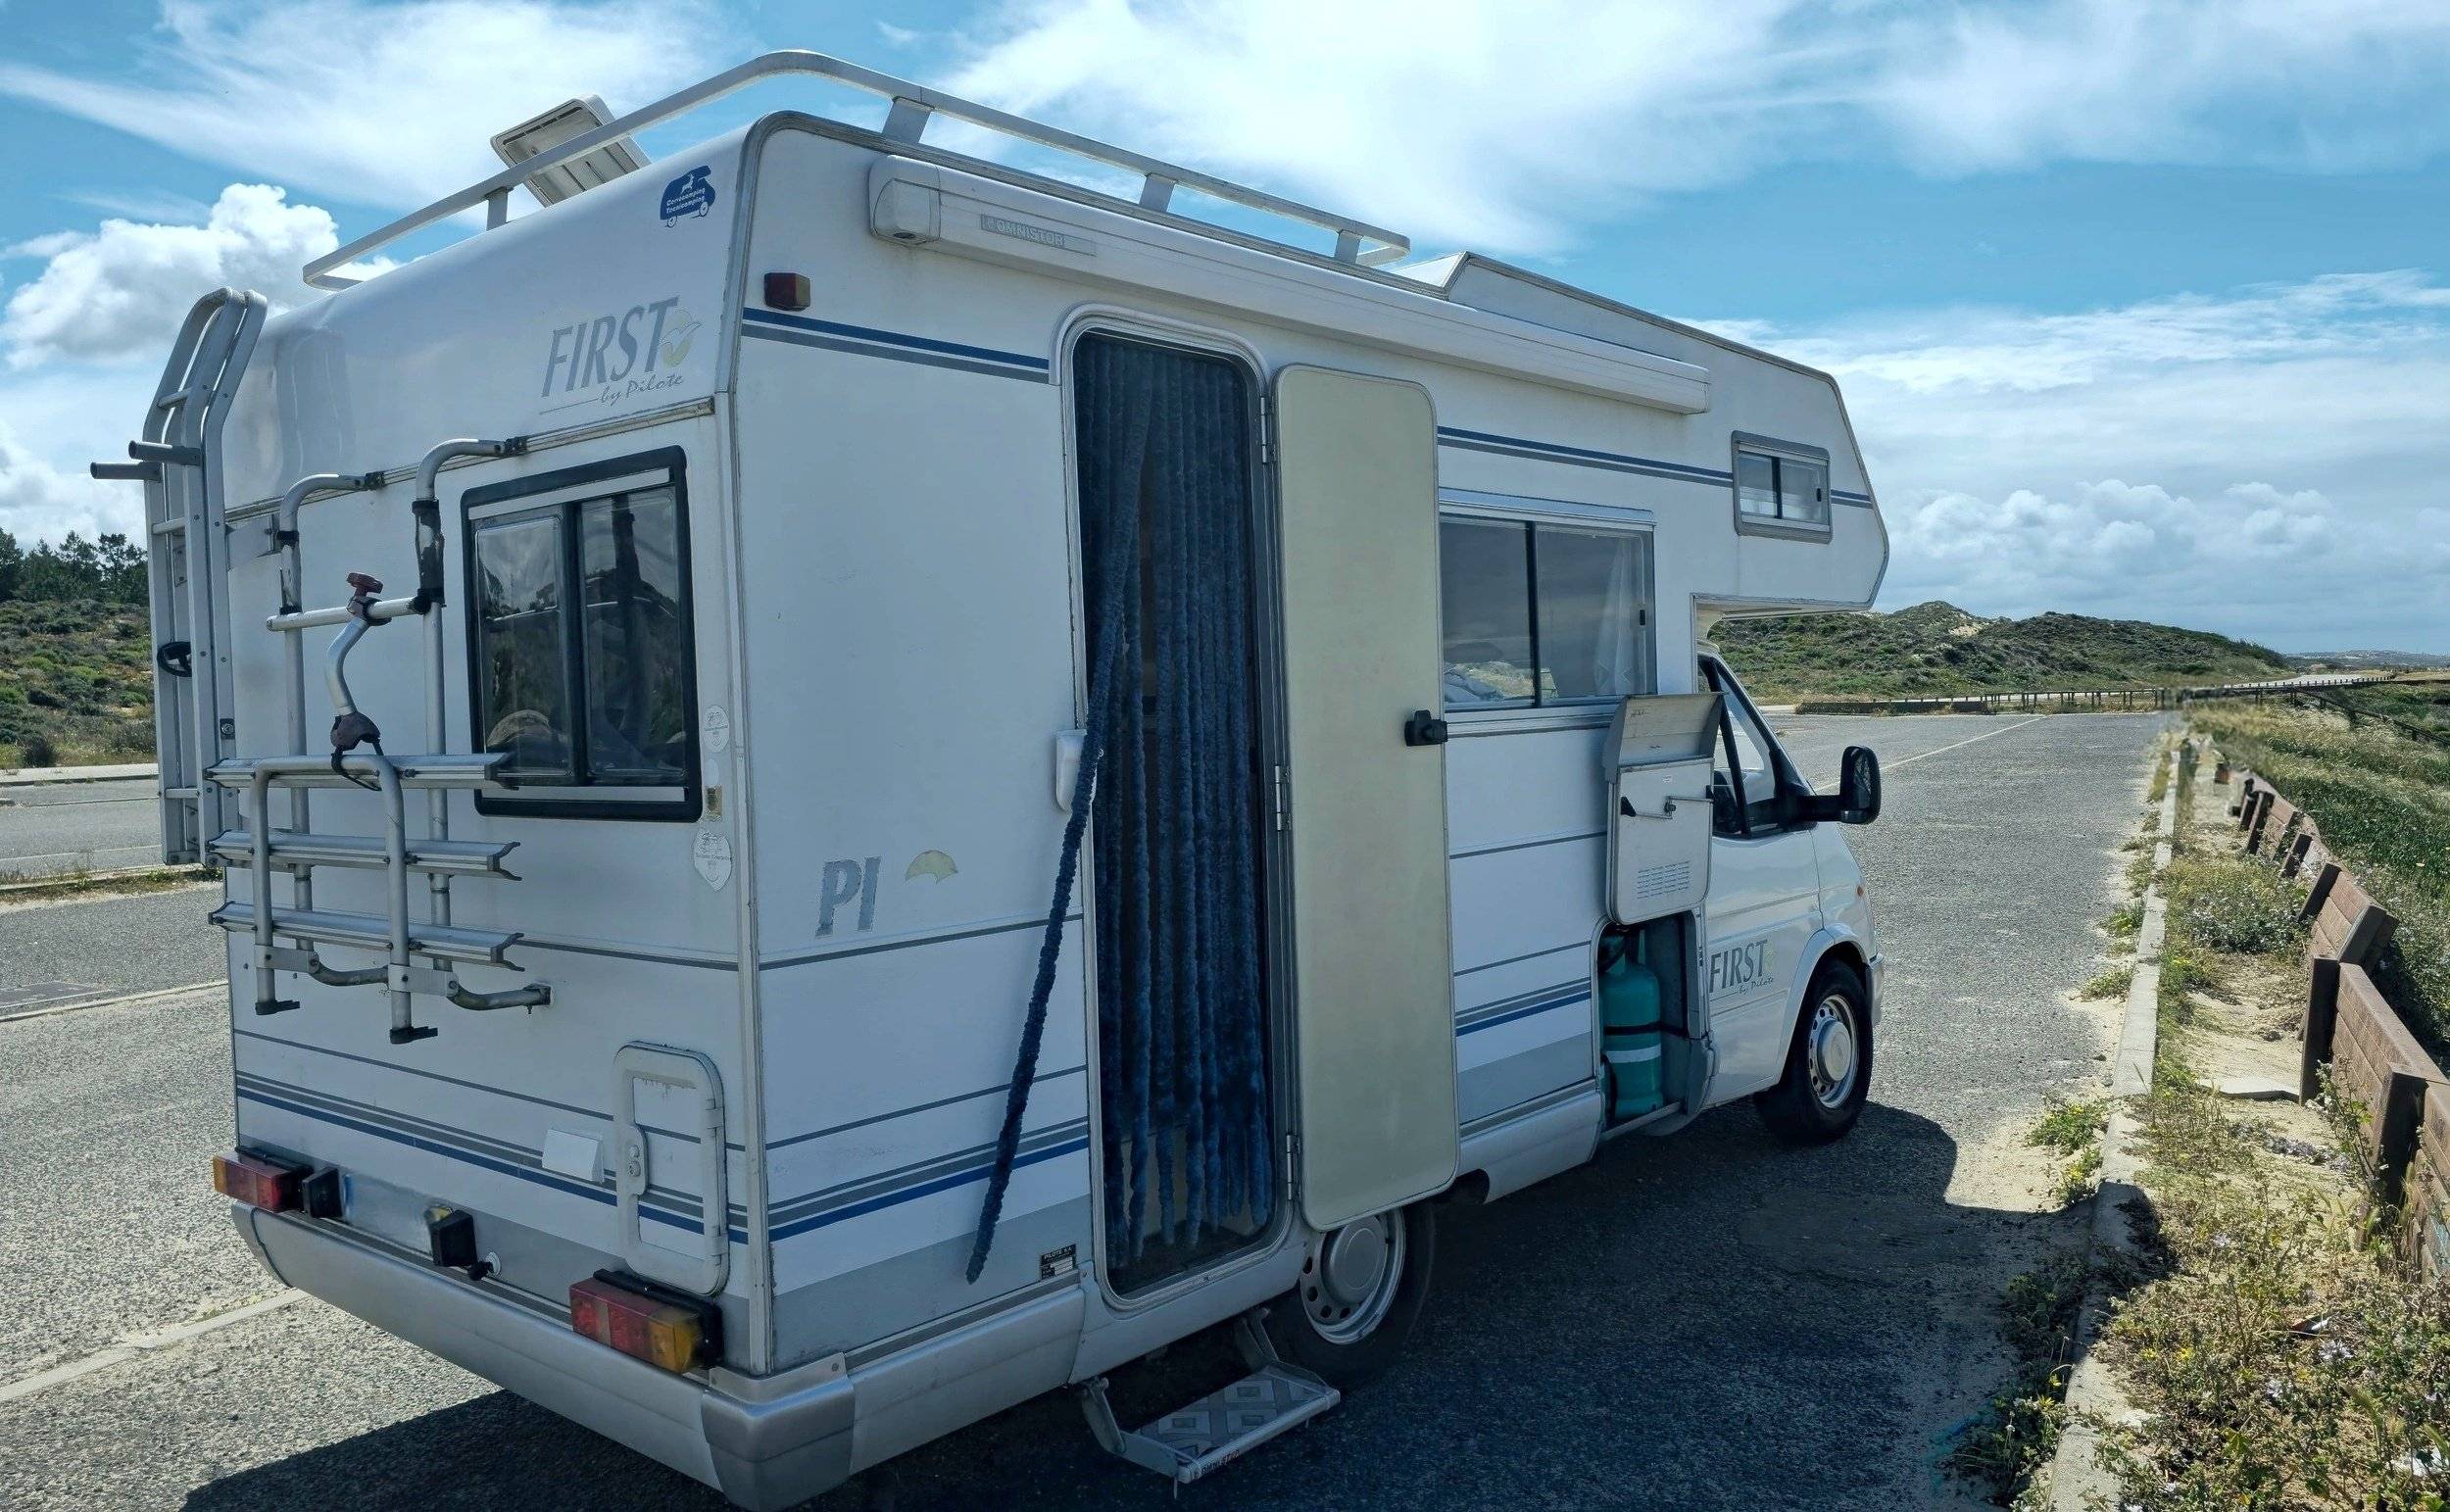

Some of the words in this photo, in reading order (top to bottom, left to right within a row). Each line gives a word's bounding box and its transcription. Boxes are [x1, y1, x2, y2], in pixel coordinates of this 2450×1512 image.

[996, 217, 1064, 248] OMNISTOR
[541, 296, 680, 398] FIRST
[601, 385, 622, 407] by
[626, 372, 684, 399] Pilote
[1708, 939, 1768, 994] FIRST
